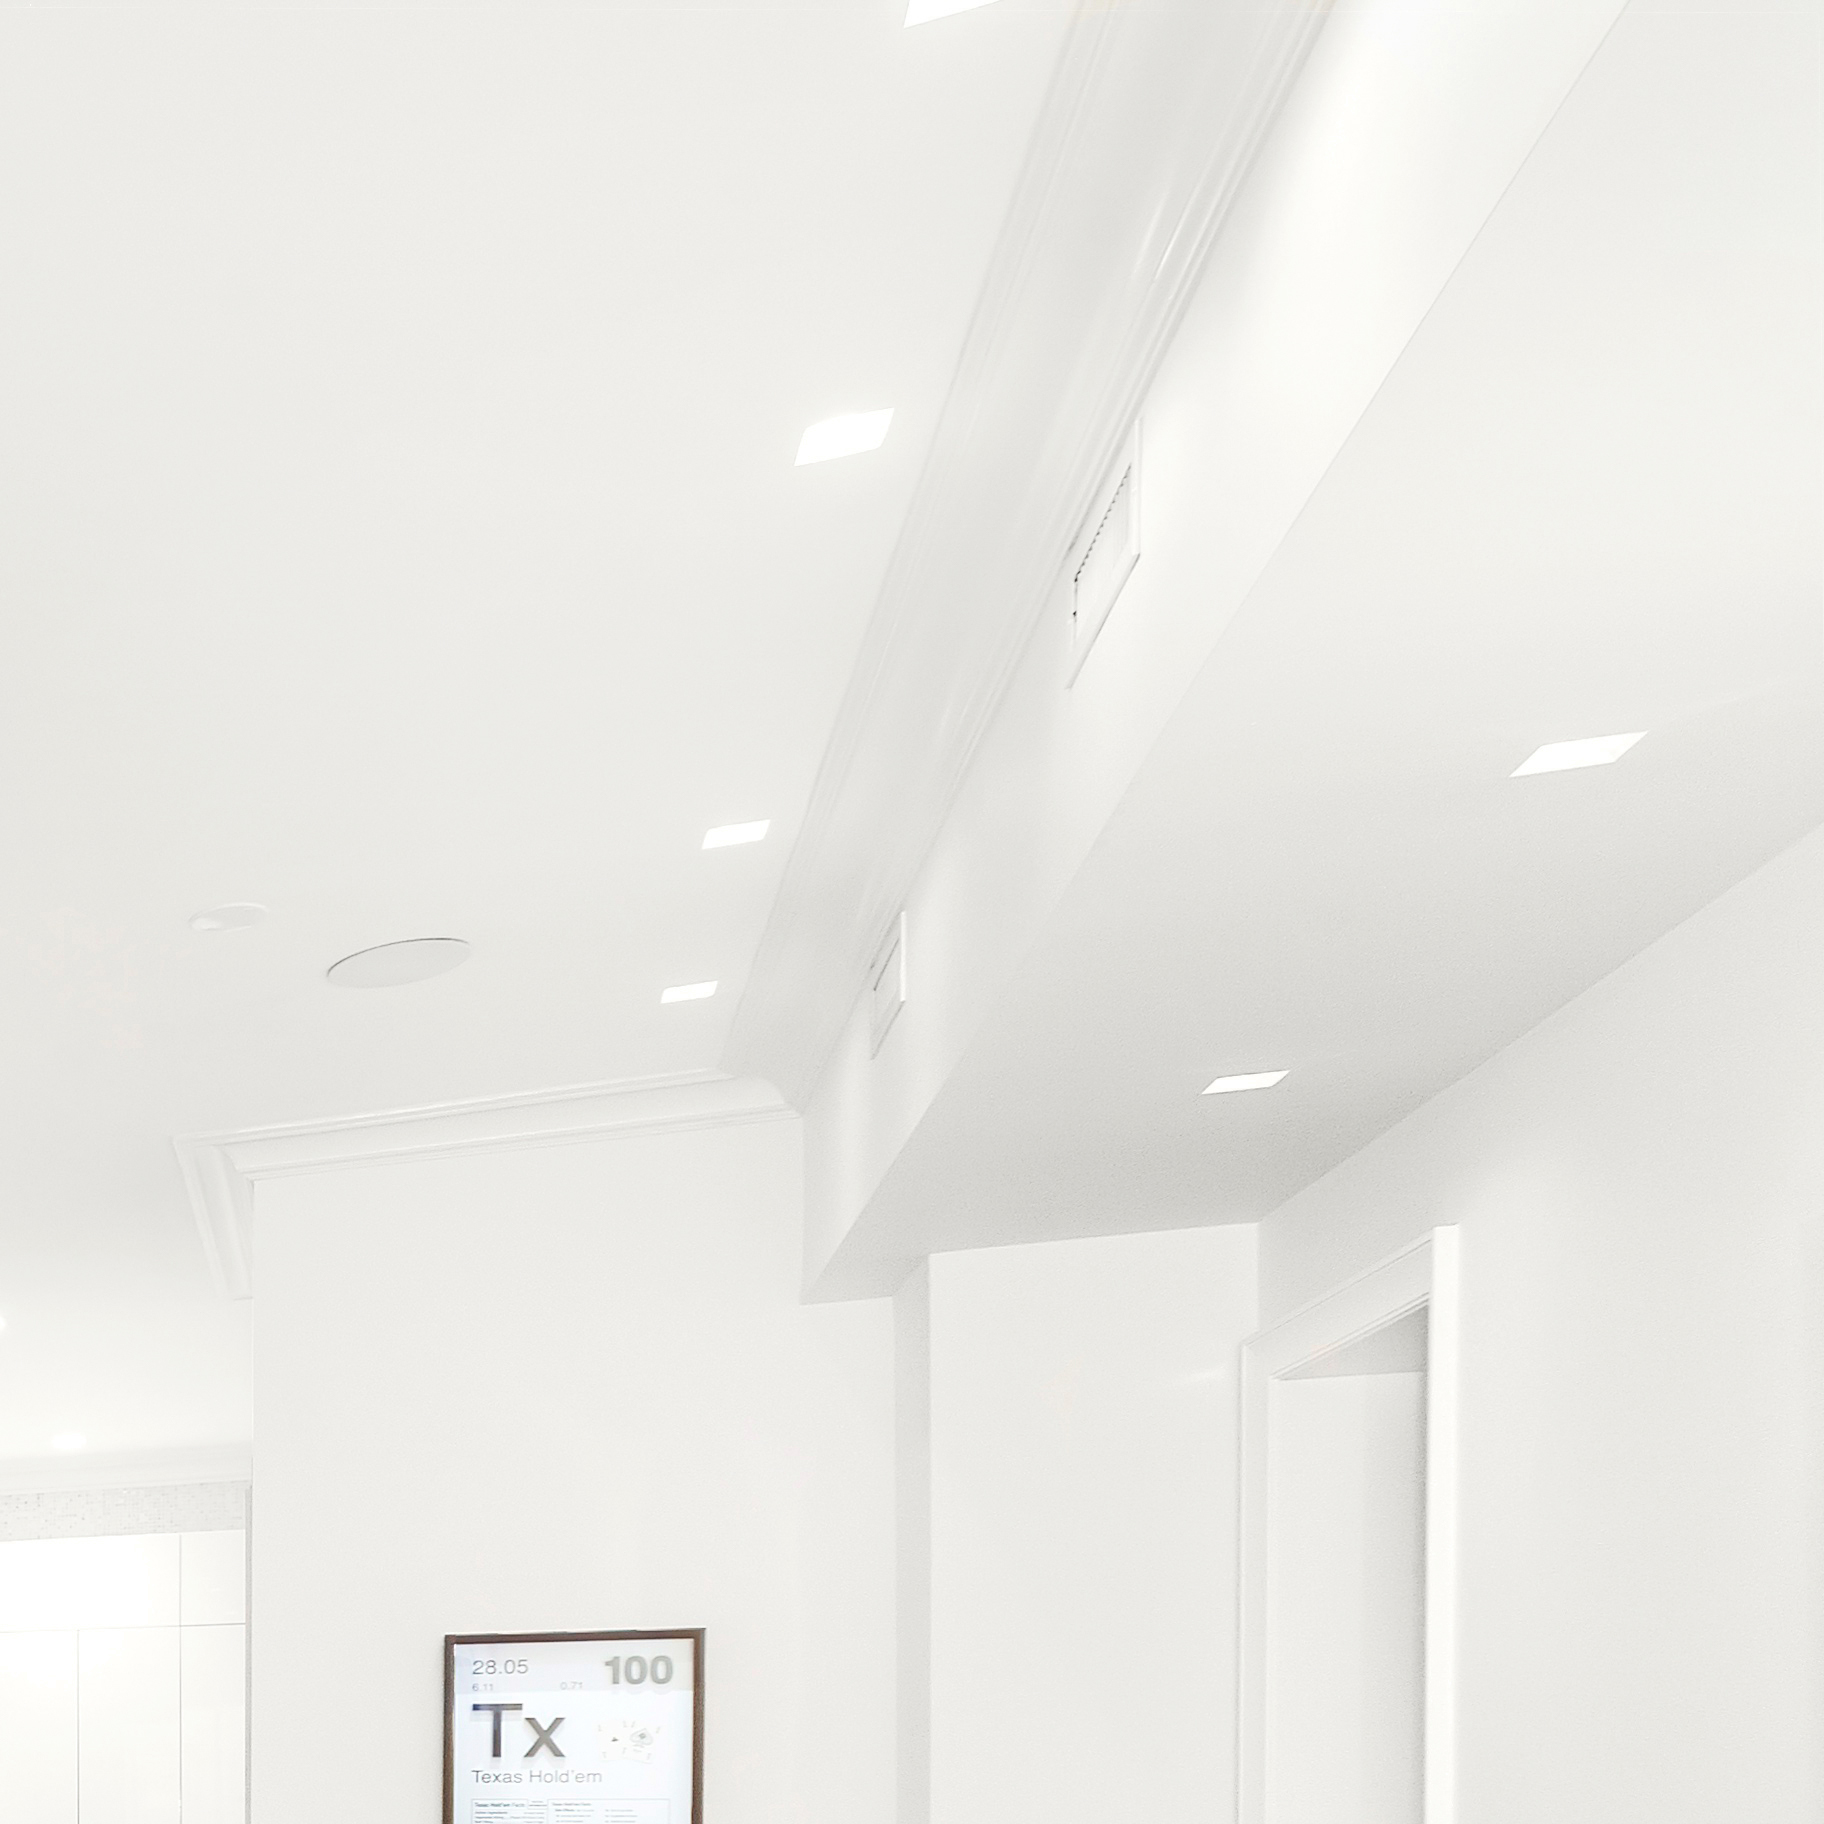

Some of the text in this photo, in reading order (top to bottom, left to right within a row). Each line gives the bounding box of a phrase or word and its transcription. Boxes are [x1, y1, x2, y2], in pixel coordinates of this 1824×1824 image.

[472, 1655, 674, 1685] 28.05 100
[472, 1681, 583, 1692] 6.11 0.71
[472, 1703, 566, 1759] Tx
[471, 1769, 603, 1784] Texas Hold'em
